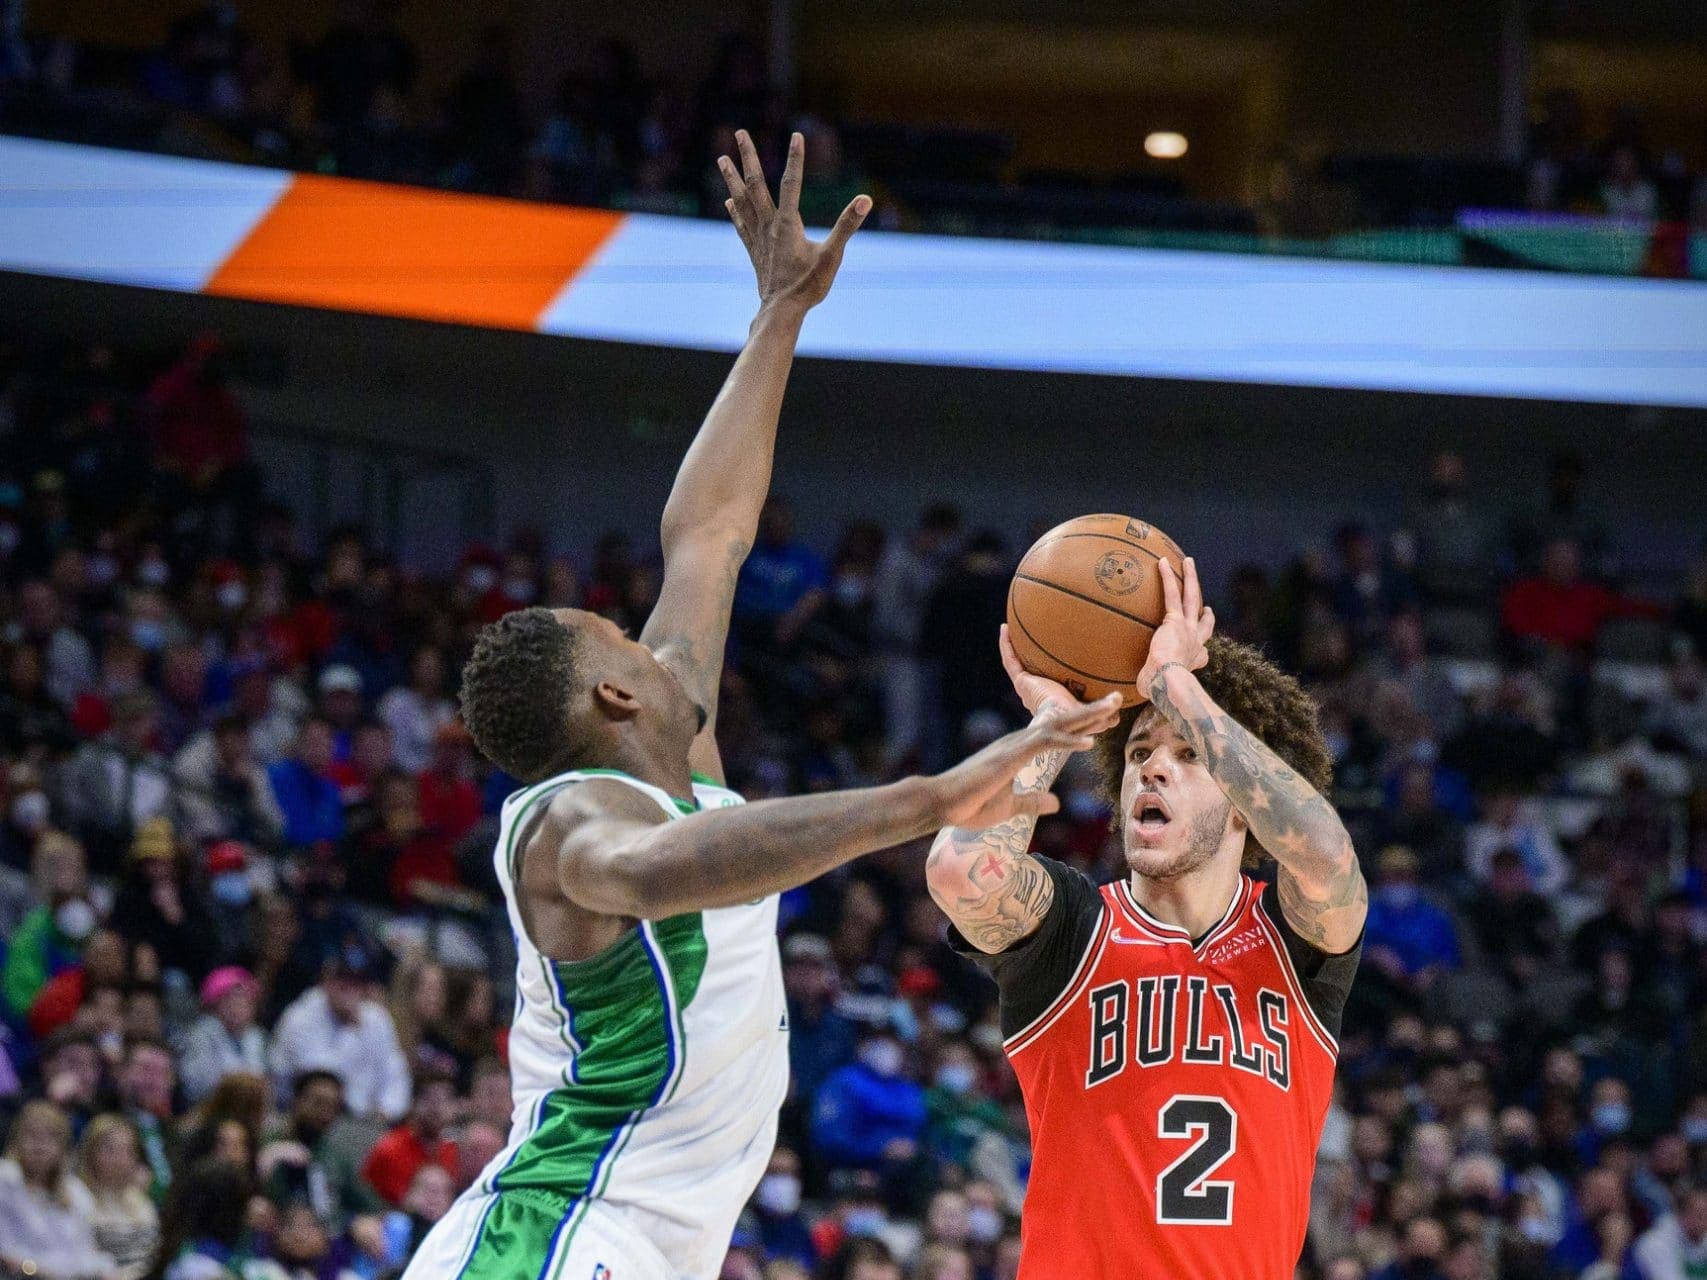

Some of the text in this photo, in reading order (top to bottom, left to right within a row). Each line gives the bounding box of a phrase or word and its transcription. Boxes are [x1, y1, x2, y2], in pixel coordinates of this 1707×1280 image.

[1211, 938, 1266, 965] EYEWEAR
[1085, 974, 1291, 1092] BULLS
[1156, 1094, 1238, 1226] 2
